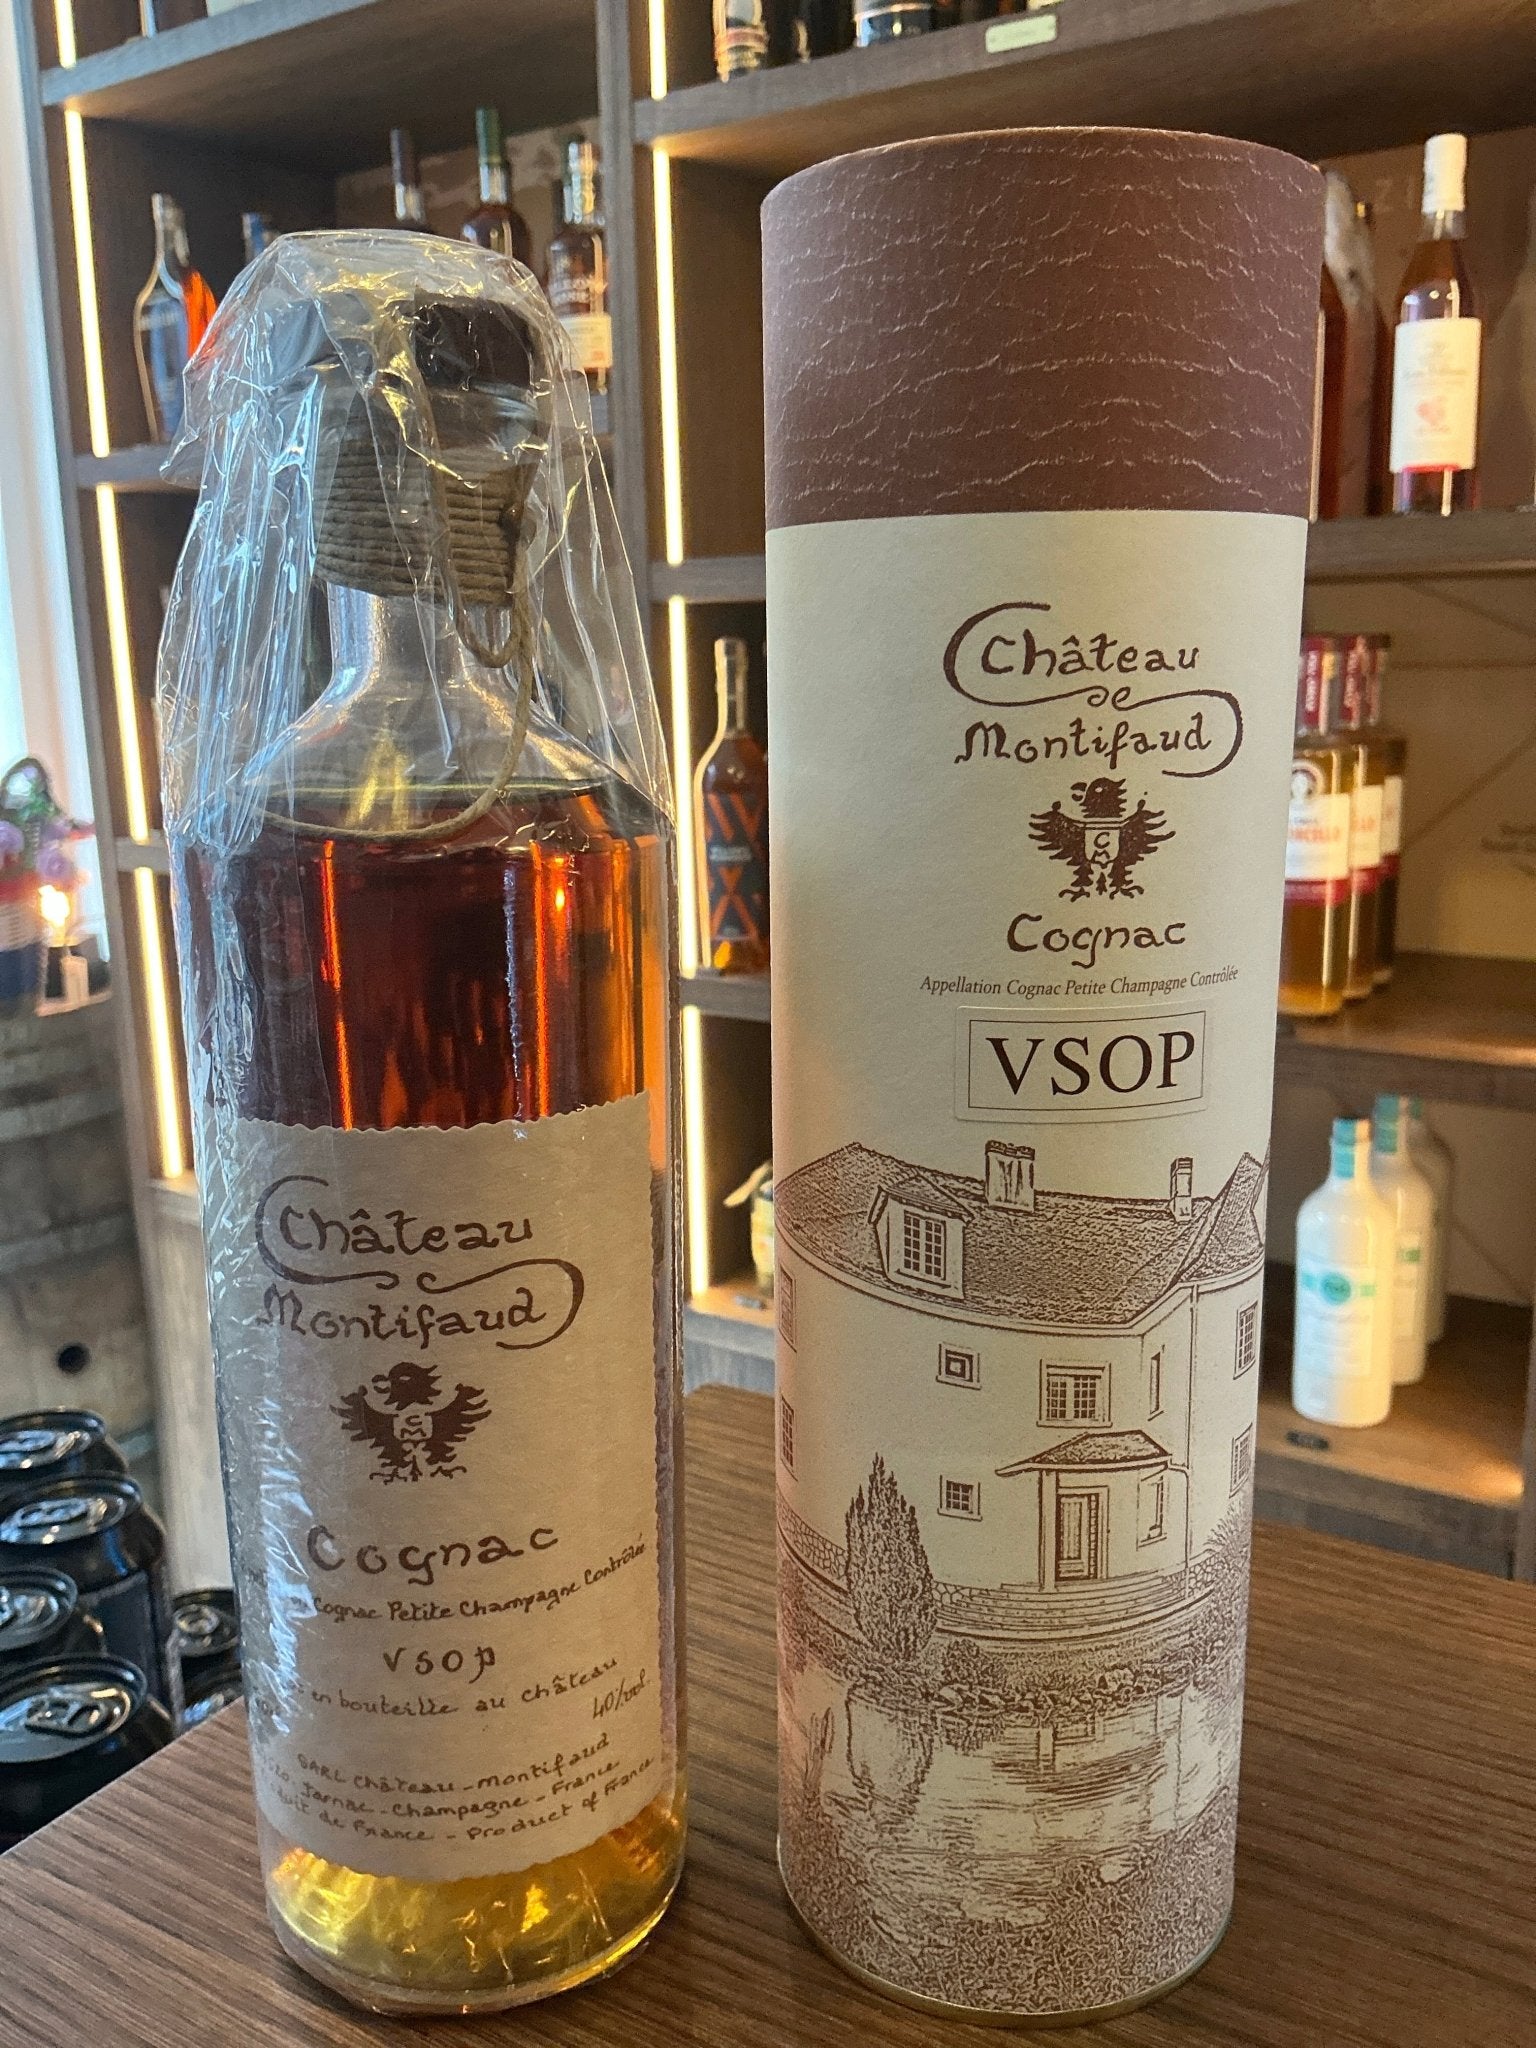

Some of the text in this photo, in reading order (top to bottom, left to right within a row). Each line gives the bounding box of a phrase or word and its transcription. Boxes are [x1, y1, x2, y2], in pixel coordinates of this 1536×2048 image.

[981, 628, 1200, 678] Château
[954, 711, 1213, 770] Montifaud
[1006, 912, 1187, 969] Cognac
[919, 964, 1239, 1001] Appellation Cognac Petite Champagne Contrôlée
[985, 1030, 1196, 1096] VSOP
[279, 1205, 533, 1256] Château
[255, 1282, 548, 1350] Montifaud
[306, 1524, 560, 1586] Cognac
[387, 1600, 455, 1622] Petite
[459, 1581, 581, 1618] Champagne
[338, 1689, 461, 1717] bouteille
[475, 1697, 506, 1712] au
[352, 1818, 435, 1841] France
[466, 1803, 574, 1841] Product
[582, 1791, 601, 1813] of
[604, 1756, 655, 1796] France
[551, 1760, 621, 1796] France
